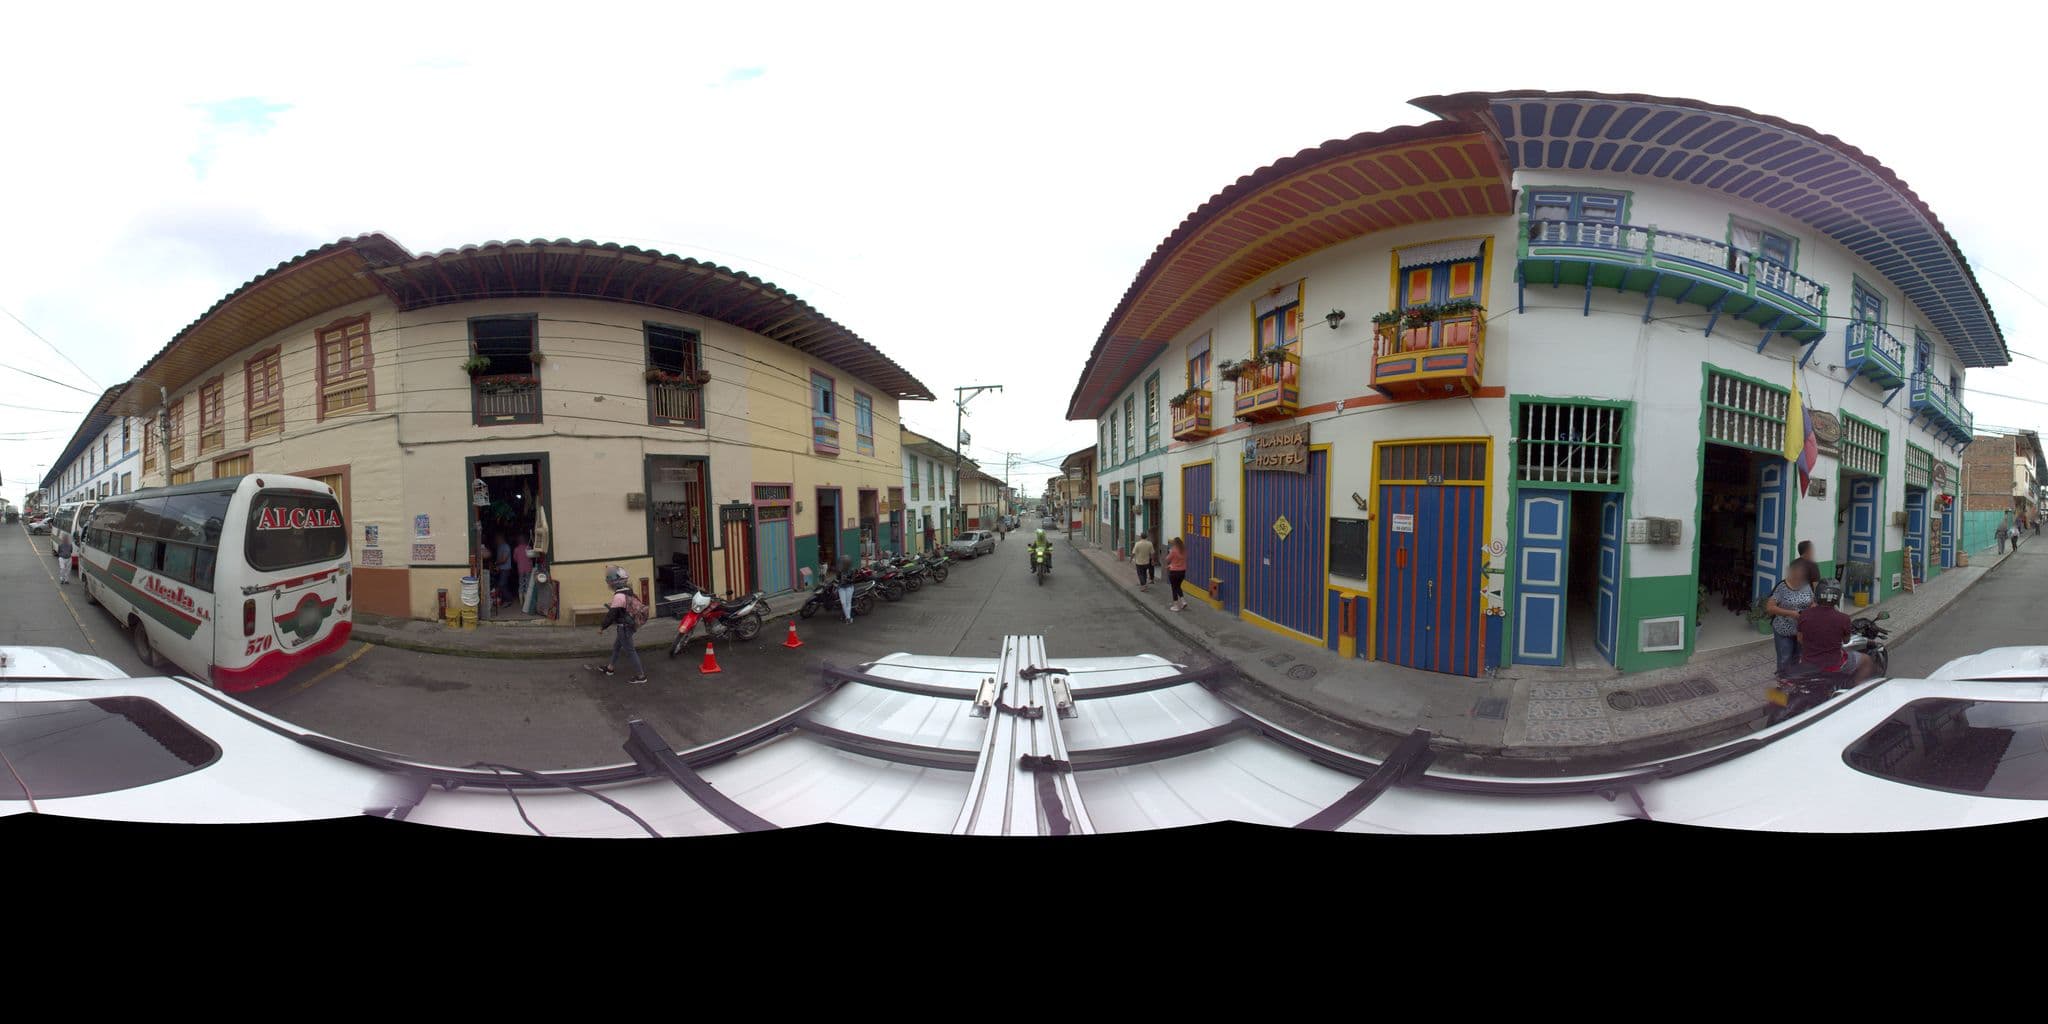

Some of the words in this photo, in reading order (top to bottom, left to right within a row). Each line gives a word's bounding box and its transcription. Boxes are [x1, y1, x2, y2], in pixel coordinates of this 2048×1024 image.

[1256, 433, 1303, 448] FILANDIA
[1255, 452, 1304, 466] HOSTEL
[257, 506, 342, 530] ALCALA
[144, 575, 194, 613] Alcala
[245, 635, 272, 656] 570
